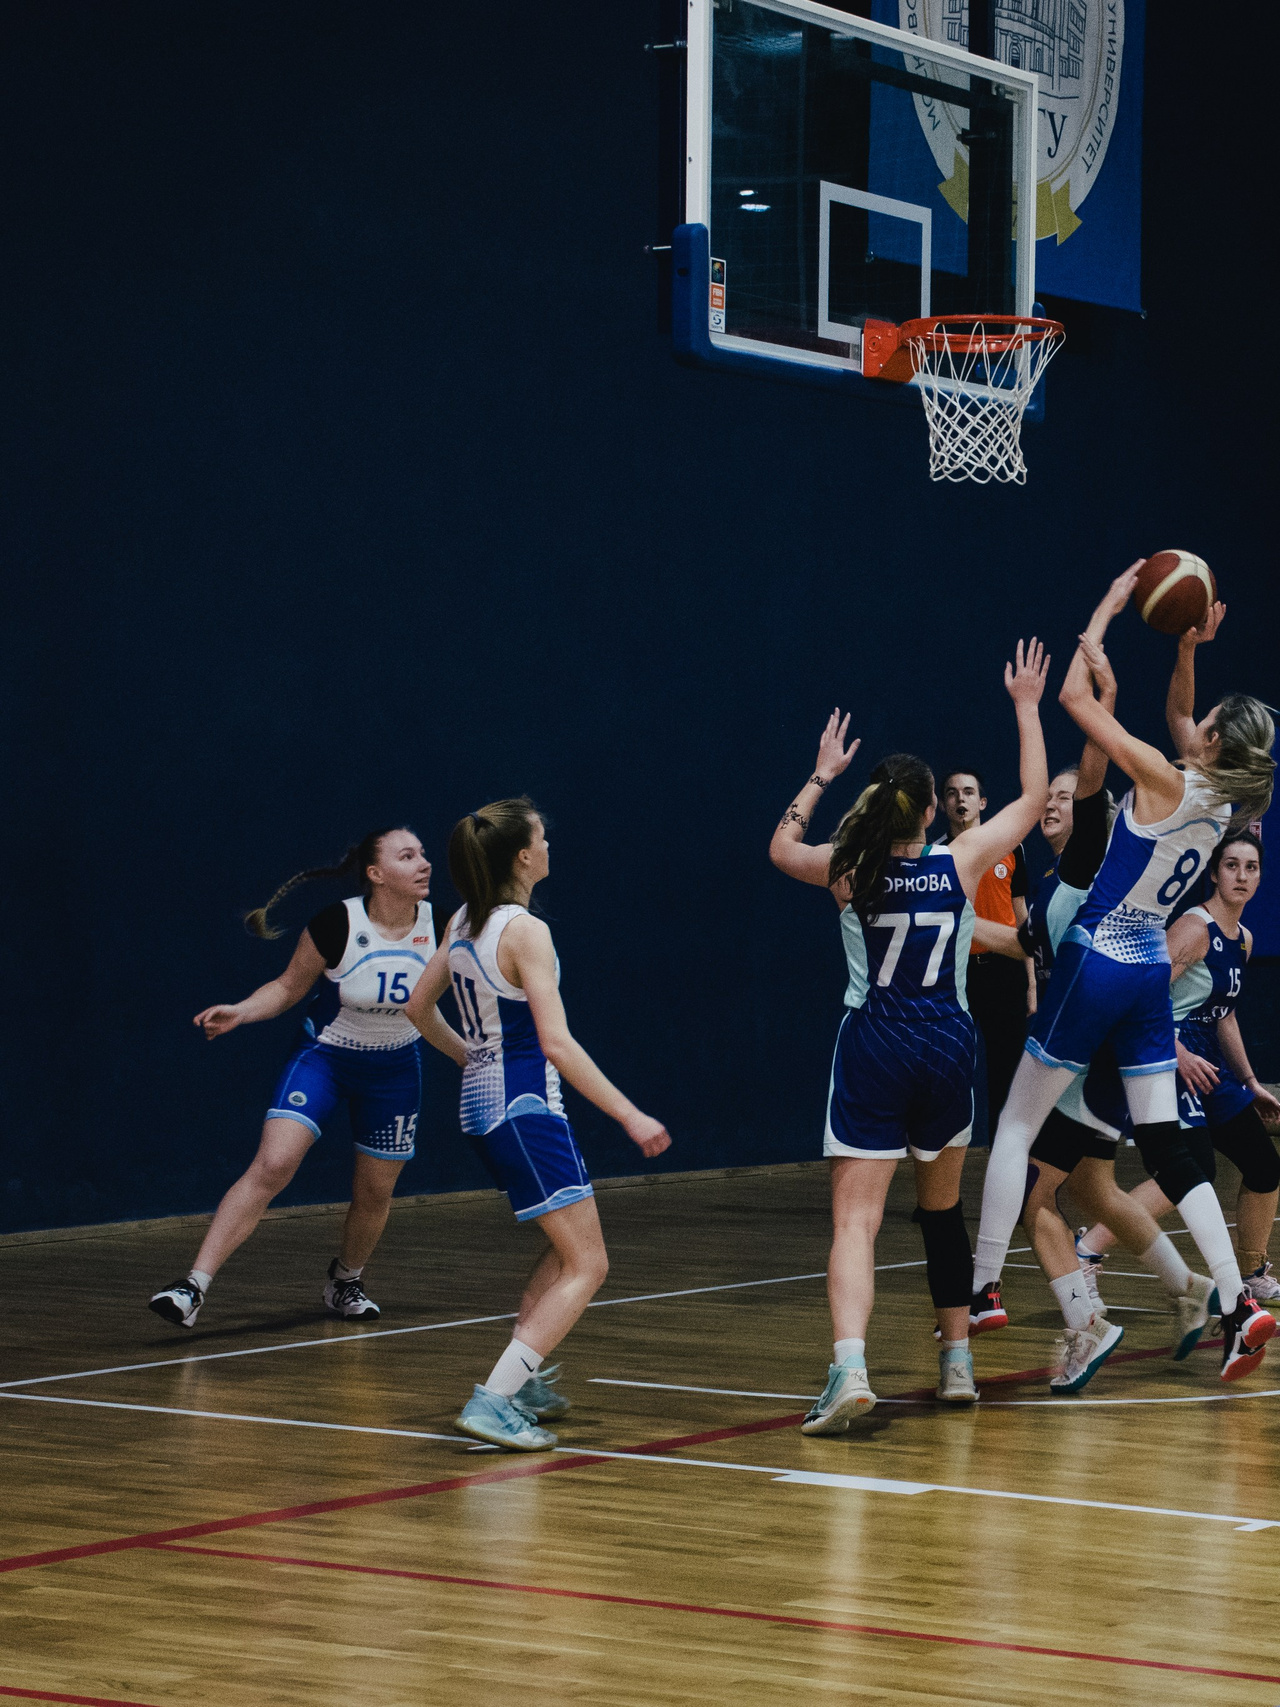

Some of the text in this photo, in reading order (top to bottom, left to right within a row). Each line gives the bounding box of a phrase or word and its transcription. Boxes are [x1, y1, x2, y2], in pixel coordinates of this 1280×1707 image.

[1081, 1, 1117, 174] УНИВЕРСИТЕТ
[1157, 848, 1200, 906] 8
[867, 911, 955, 987] 77
[377, 971, 411, 1005] 15
[453, 971, 488, 1044] 11
[1226, 967, 1241, 998] 15
[394, 1113, 418, 1146] 15
